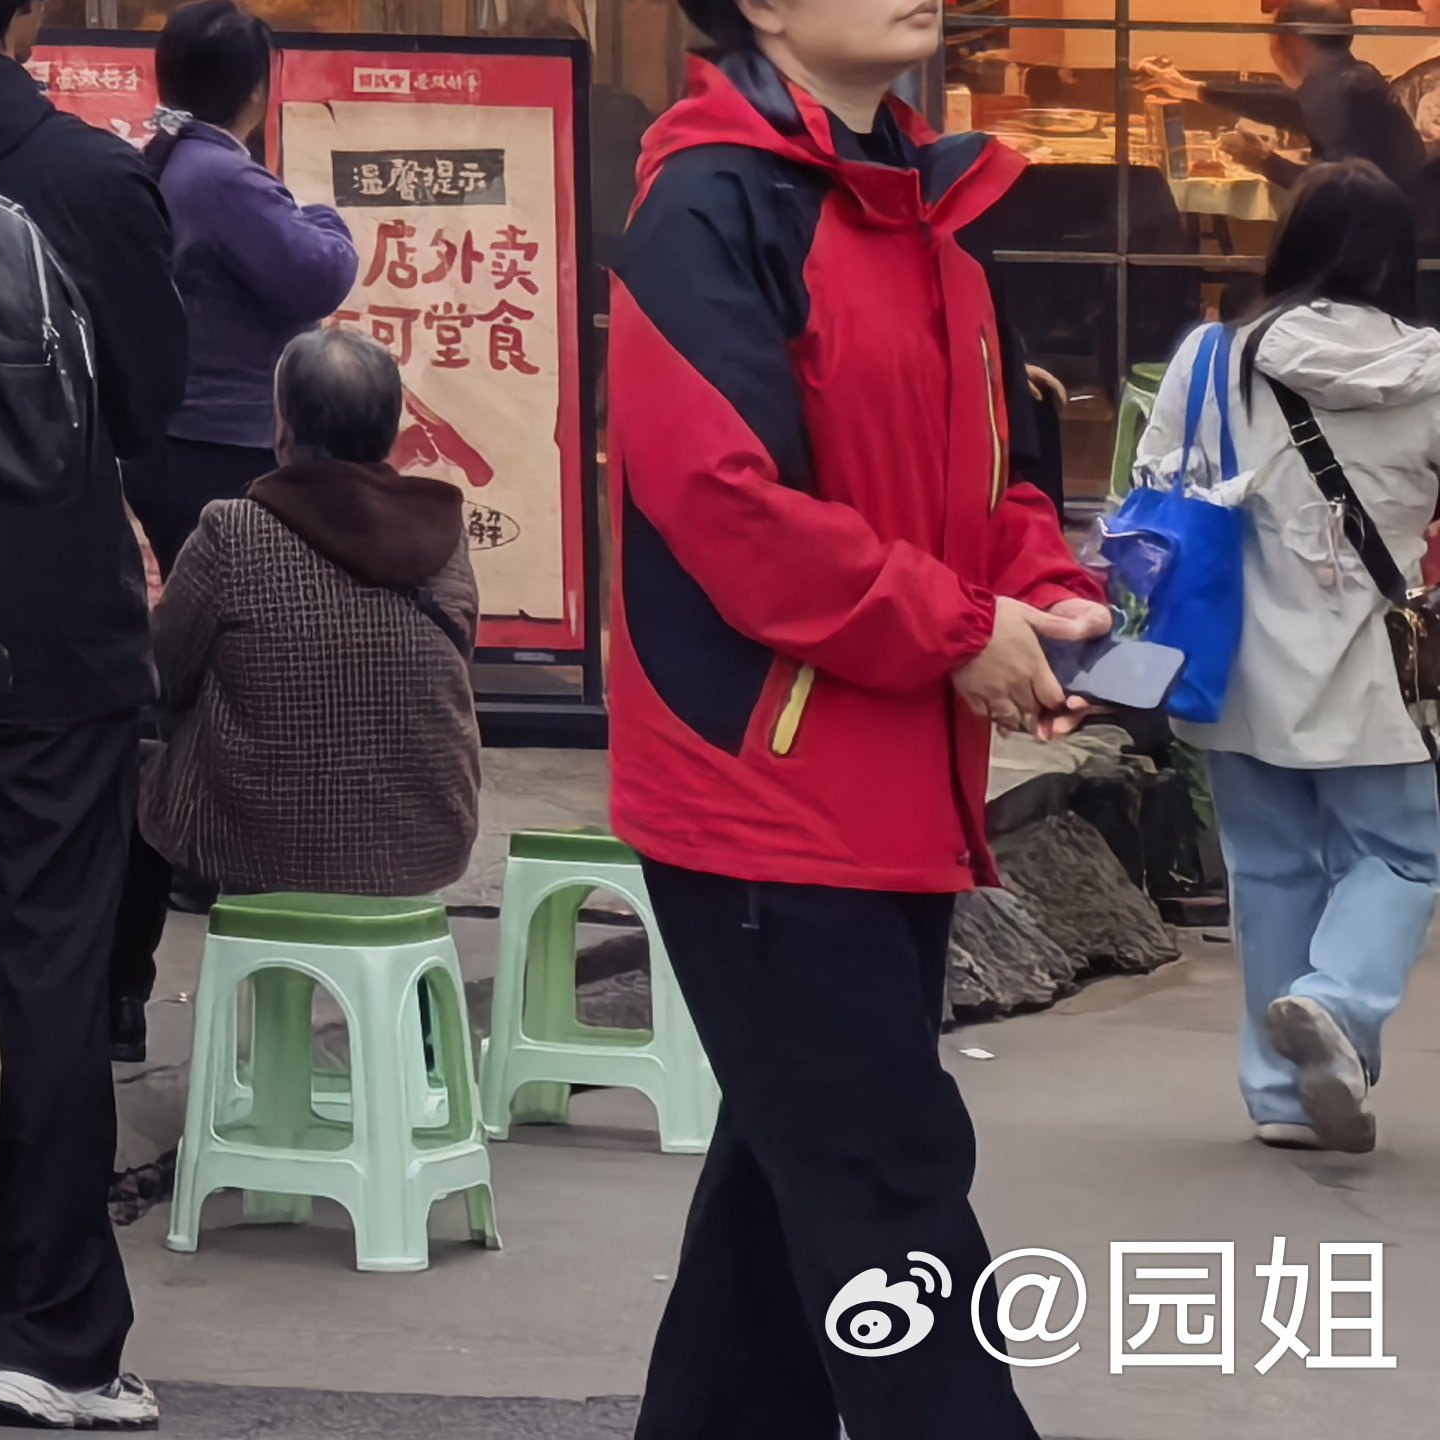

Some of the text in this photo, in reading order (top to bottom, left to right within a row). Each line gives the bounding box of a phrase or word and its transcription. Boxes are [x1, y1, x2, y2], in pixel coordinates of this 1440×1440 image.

[353, 158, 487, 202] 温馨提示
[323, 301, 540, 376] 可堂食
